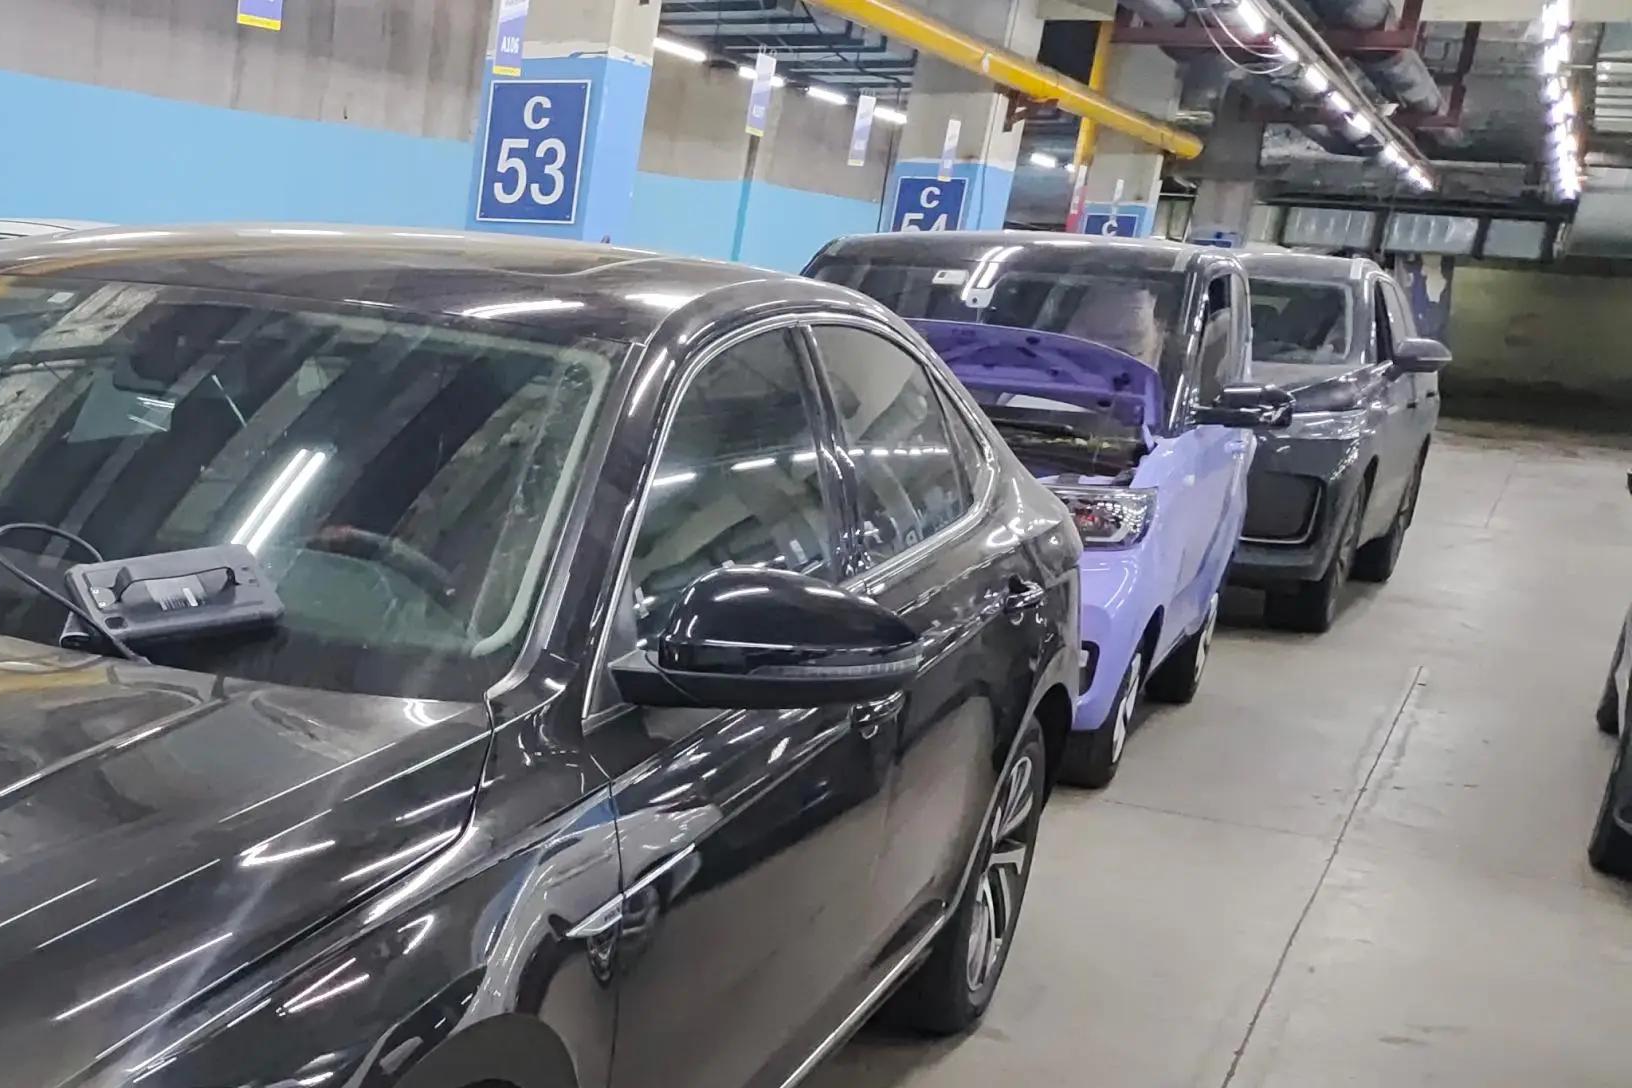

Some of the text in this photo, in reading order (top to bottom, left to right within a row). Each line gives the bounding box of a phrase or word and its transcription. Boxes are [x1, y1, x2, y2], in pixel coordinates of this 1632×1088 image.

[523, 95, 552, 130] C
[493, 137, 567, 205] 53
[919, 186, 941, 208] C
